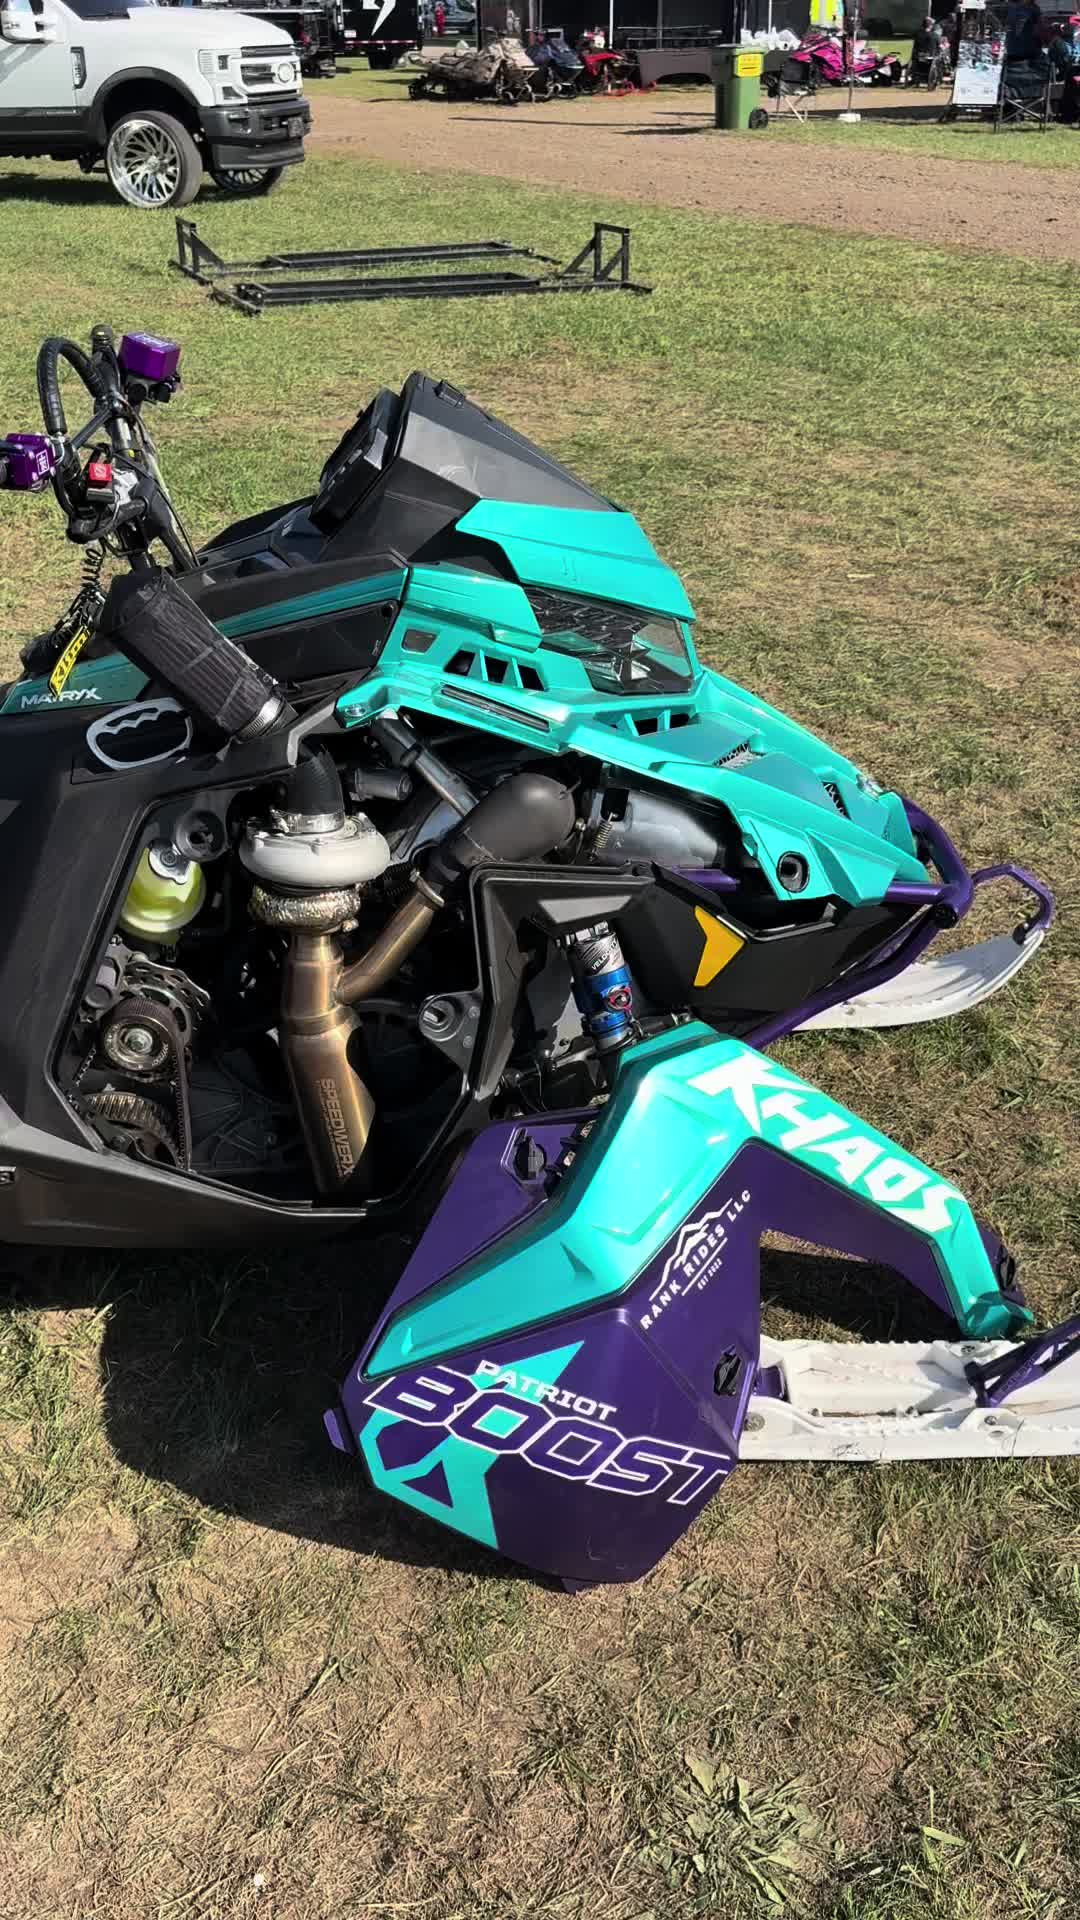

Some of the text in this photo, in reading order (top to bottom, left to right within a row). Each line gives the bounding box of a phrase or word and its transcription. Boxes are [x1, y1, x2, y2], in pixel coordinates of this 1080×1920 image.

[321, 1079, 355, 1175] SPEEDWERX
[687, 1050, 969, 1233] KHAOS
[640, 1190, 751, 1330] RANK RIDES LLC
[362, 1364, 731, 1505] BOOST
[476, 1360, 617, 1421] PATRIOT
